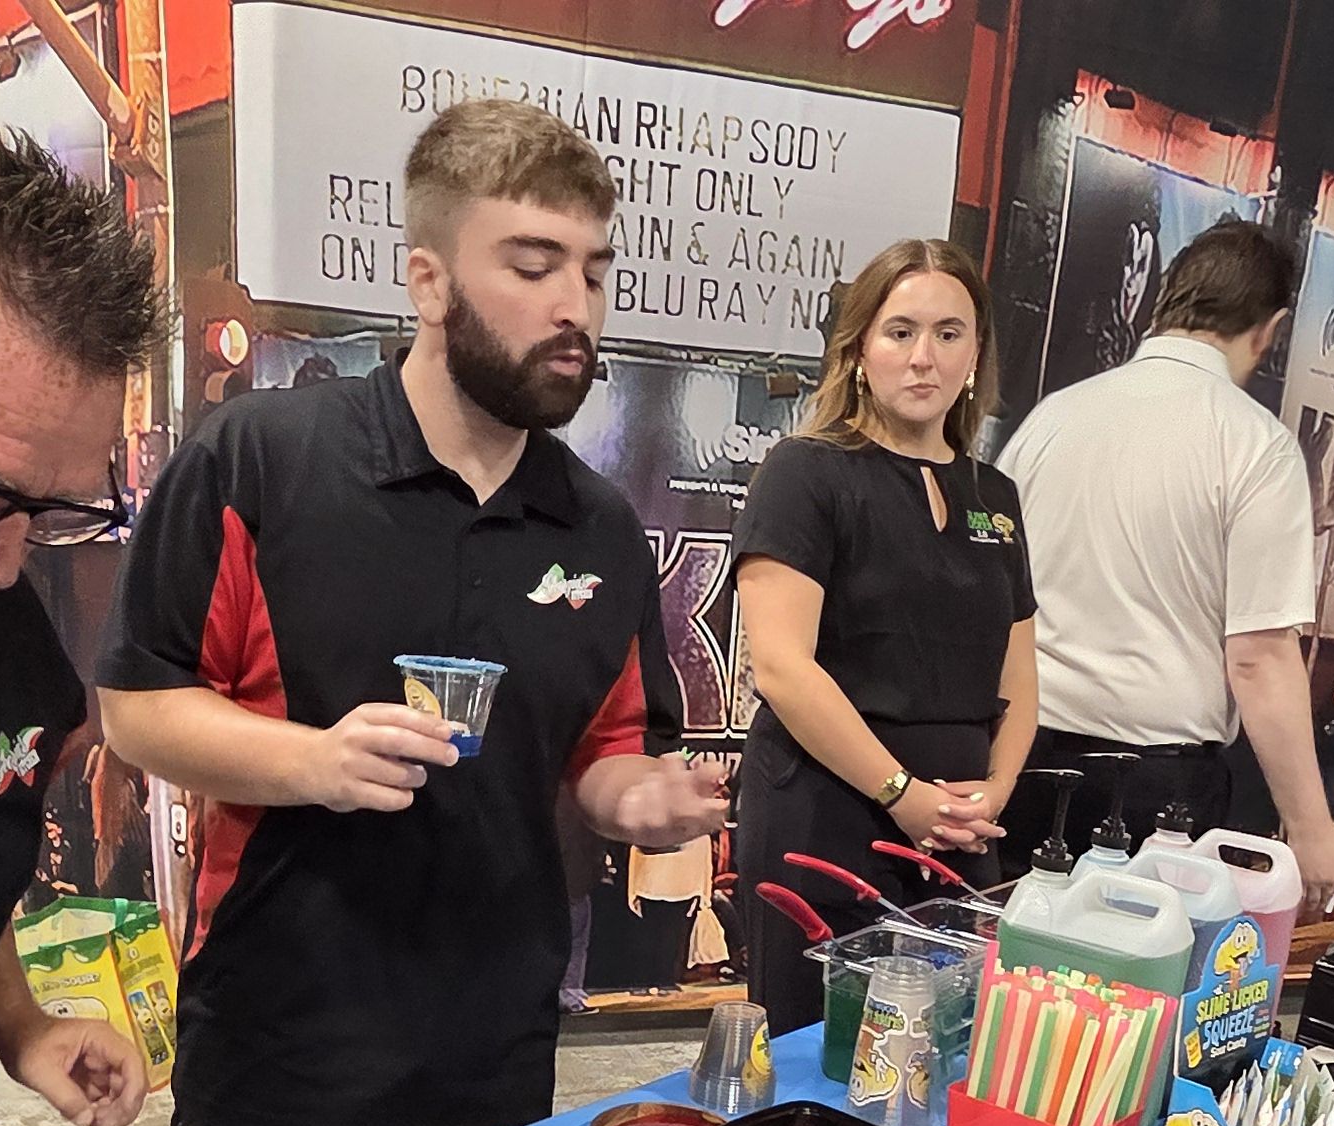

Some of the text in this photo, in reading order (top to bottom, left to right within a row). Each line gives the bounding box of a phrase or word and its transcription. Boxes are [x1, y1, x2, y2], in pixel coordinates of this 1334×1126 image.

[636, 101, 848, 175] RHAPSODY
[694, 167, 795, 221] ONLY
[686, 221, 710, 266] &
[727, 226, 845, 280] AGAIN
[320, 232, 376, 284] ON
[614, 269, 685, 318] BLU
[697, 278, 777, 326] RAY
[1195, 992, 1231, 1025] SLIME
[1232, 980, 1269, 1010] LICKER
[1202, 1006, 1255, 1050] SQUEEZE
